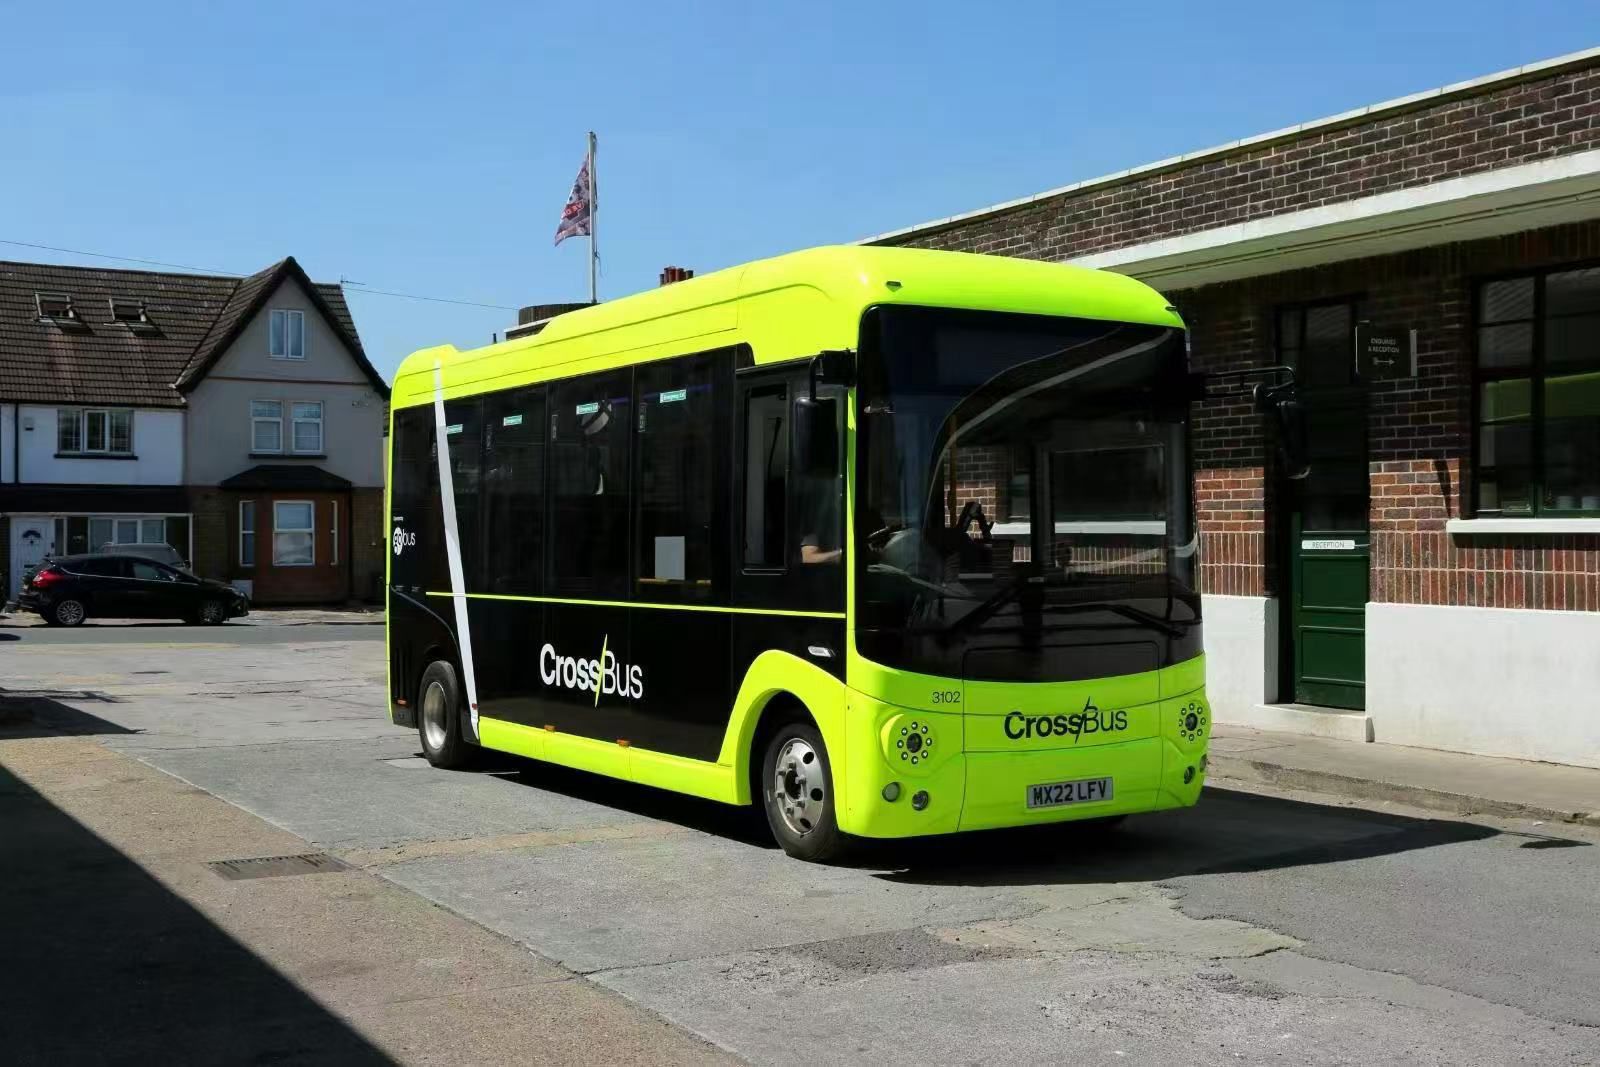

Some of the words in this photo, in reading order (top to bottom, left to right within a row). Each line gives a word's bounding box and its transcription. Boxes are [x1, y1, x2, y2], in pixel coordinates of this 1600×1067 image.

[1312, 541, 1345, 549] RECEPTION
[932, 691, 961, 704] 3102
[1033, 783, 1074, 806] MX22
[1077, 780, 1107, 801] LFV
